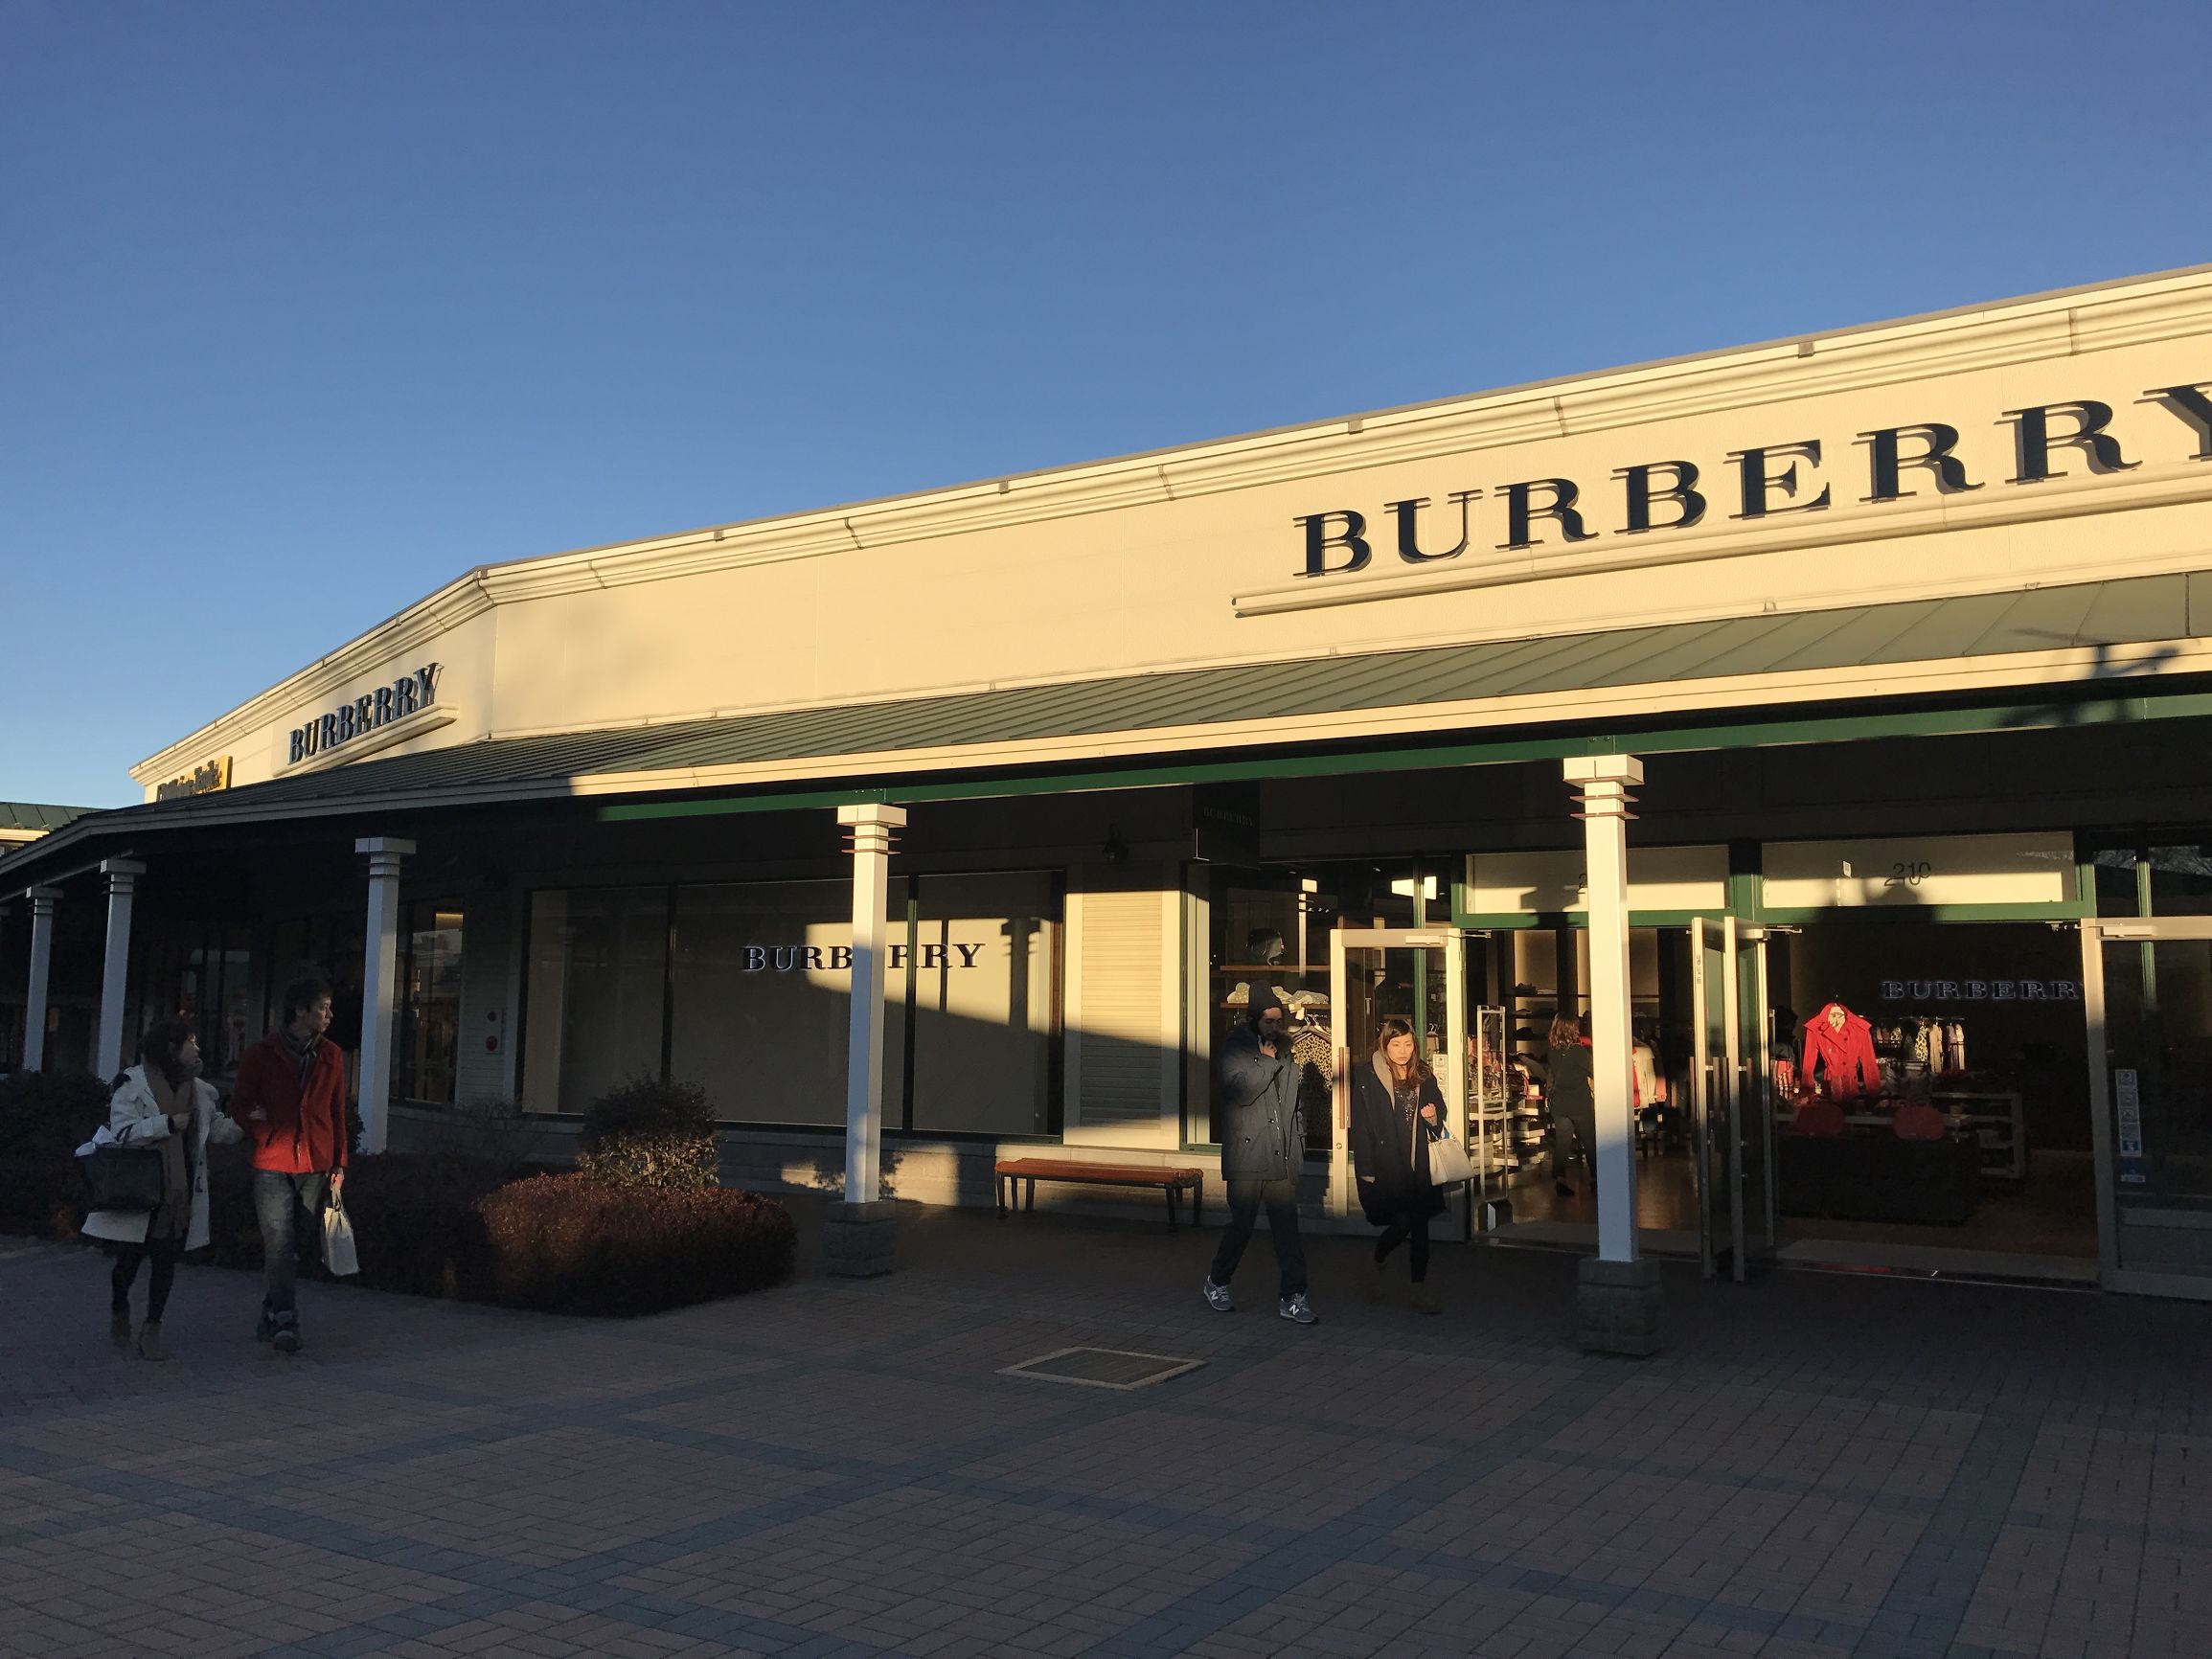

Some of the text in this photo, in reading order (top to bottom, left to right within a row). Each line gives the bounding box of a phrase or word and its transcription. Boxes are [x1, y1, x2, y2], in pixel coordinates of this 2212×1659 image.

[288, 663, 440, 765] BURBERRY
[1892, 862, 1931, 879] 210
[740, 943, 985, 970] BURBRRY
[1881, 980, 2084, 1000] BURBERR
